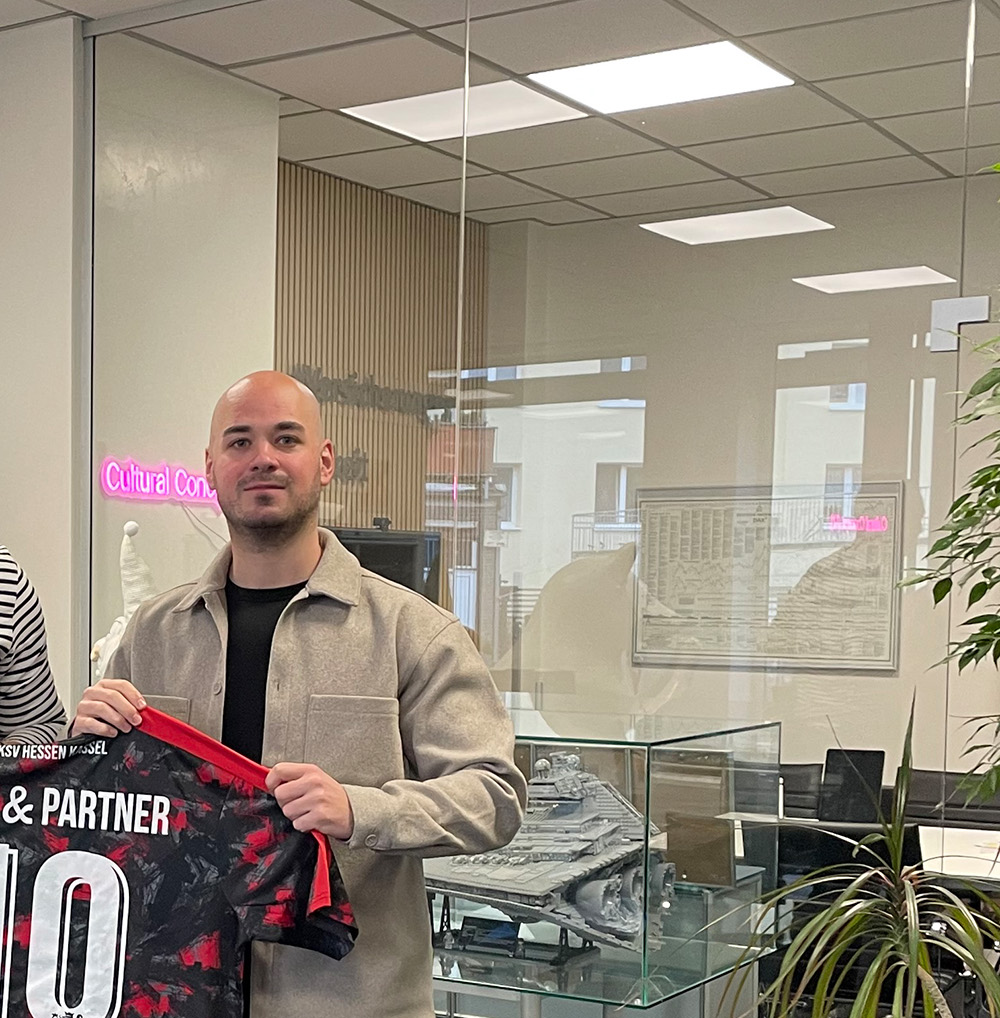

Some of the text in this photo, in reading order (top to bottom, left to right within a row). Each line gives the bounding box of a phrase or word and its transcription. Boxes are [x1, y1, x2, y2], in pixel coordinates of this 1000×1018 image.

[106, 461, 170, 495] Cultural
[22, 744, 67, 760] HESSEN
[2, 785, 34, 825] &
[41, 787, 171, 836] PARTNER
